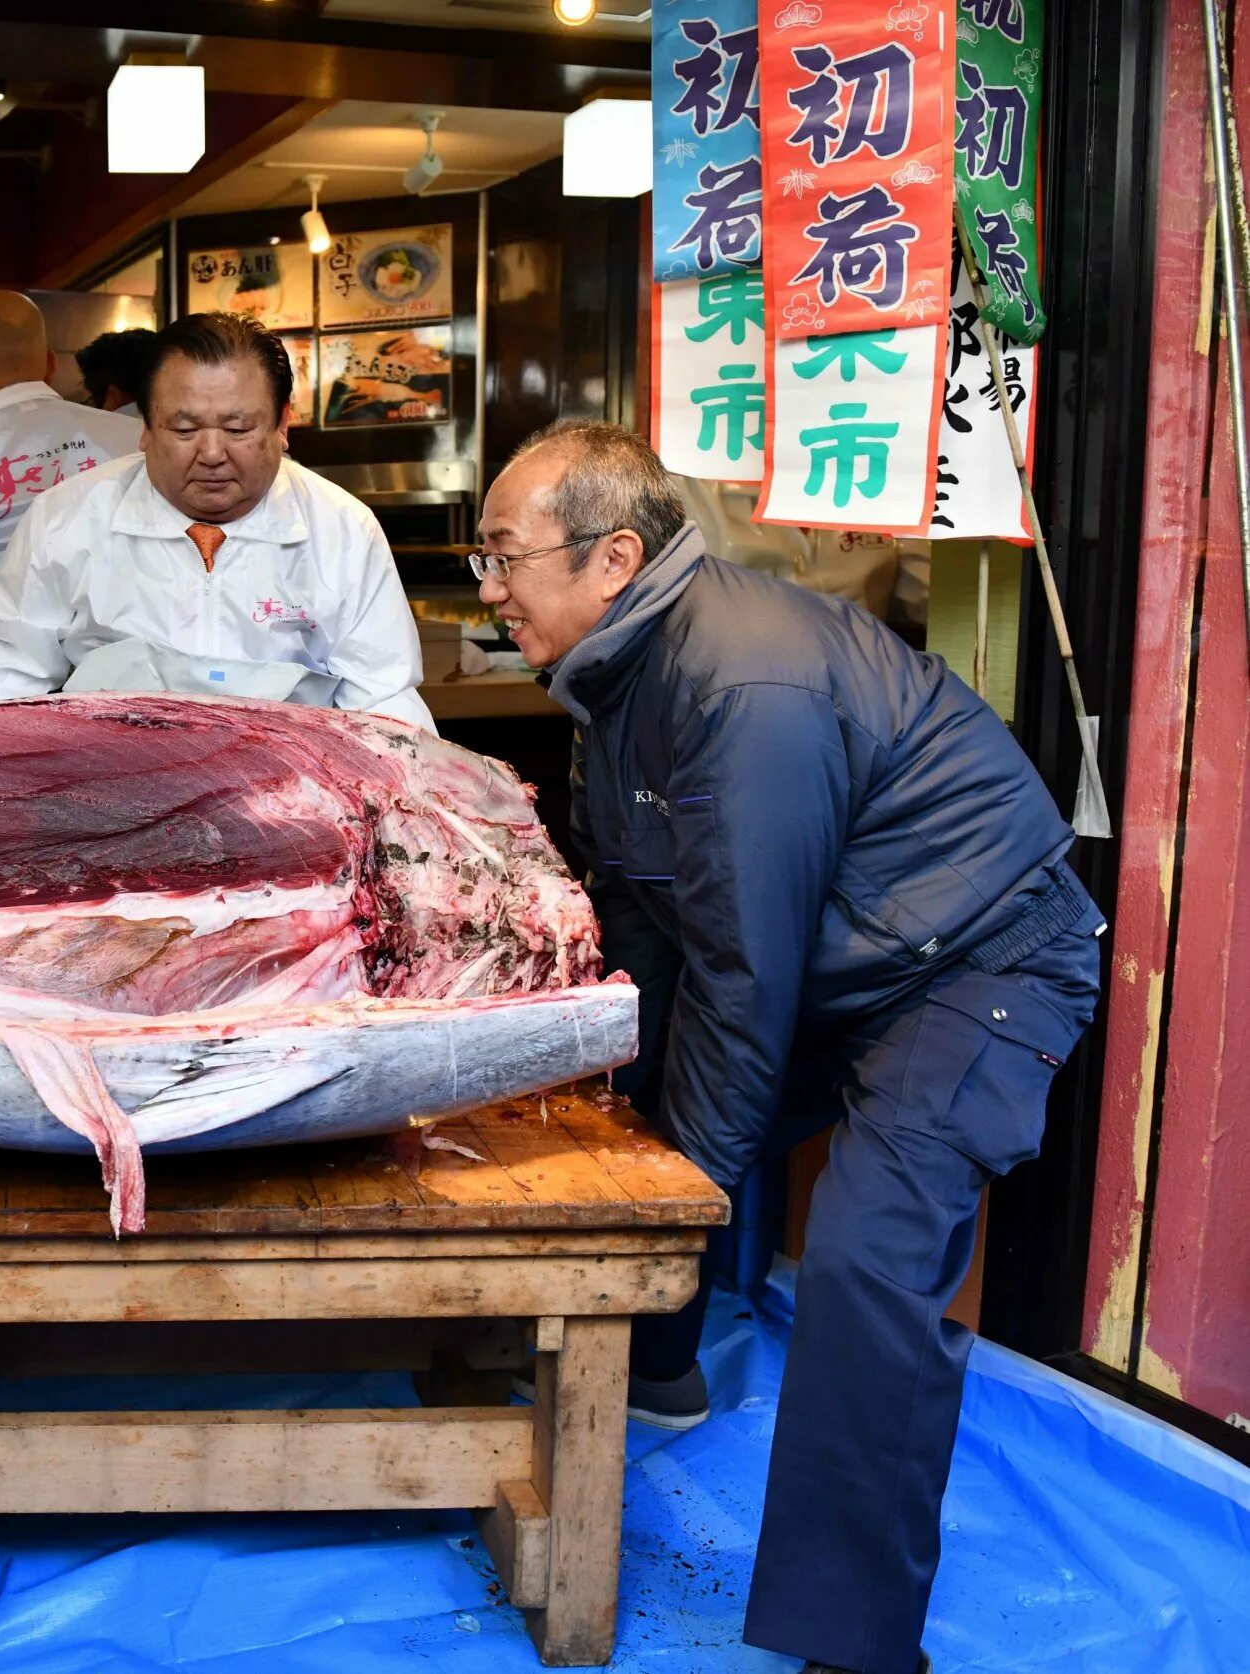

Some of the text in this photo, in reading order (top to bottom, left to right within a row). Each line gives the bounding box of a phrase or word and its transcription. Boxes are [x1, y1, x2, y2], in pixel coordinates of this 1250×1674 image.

[329, 241, 357, 297] 白子
[666, 17, 762, 274] 初荷
[787, 42, 920, 312] 初荷
